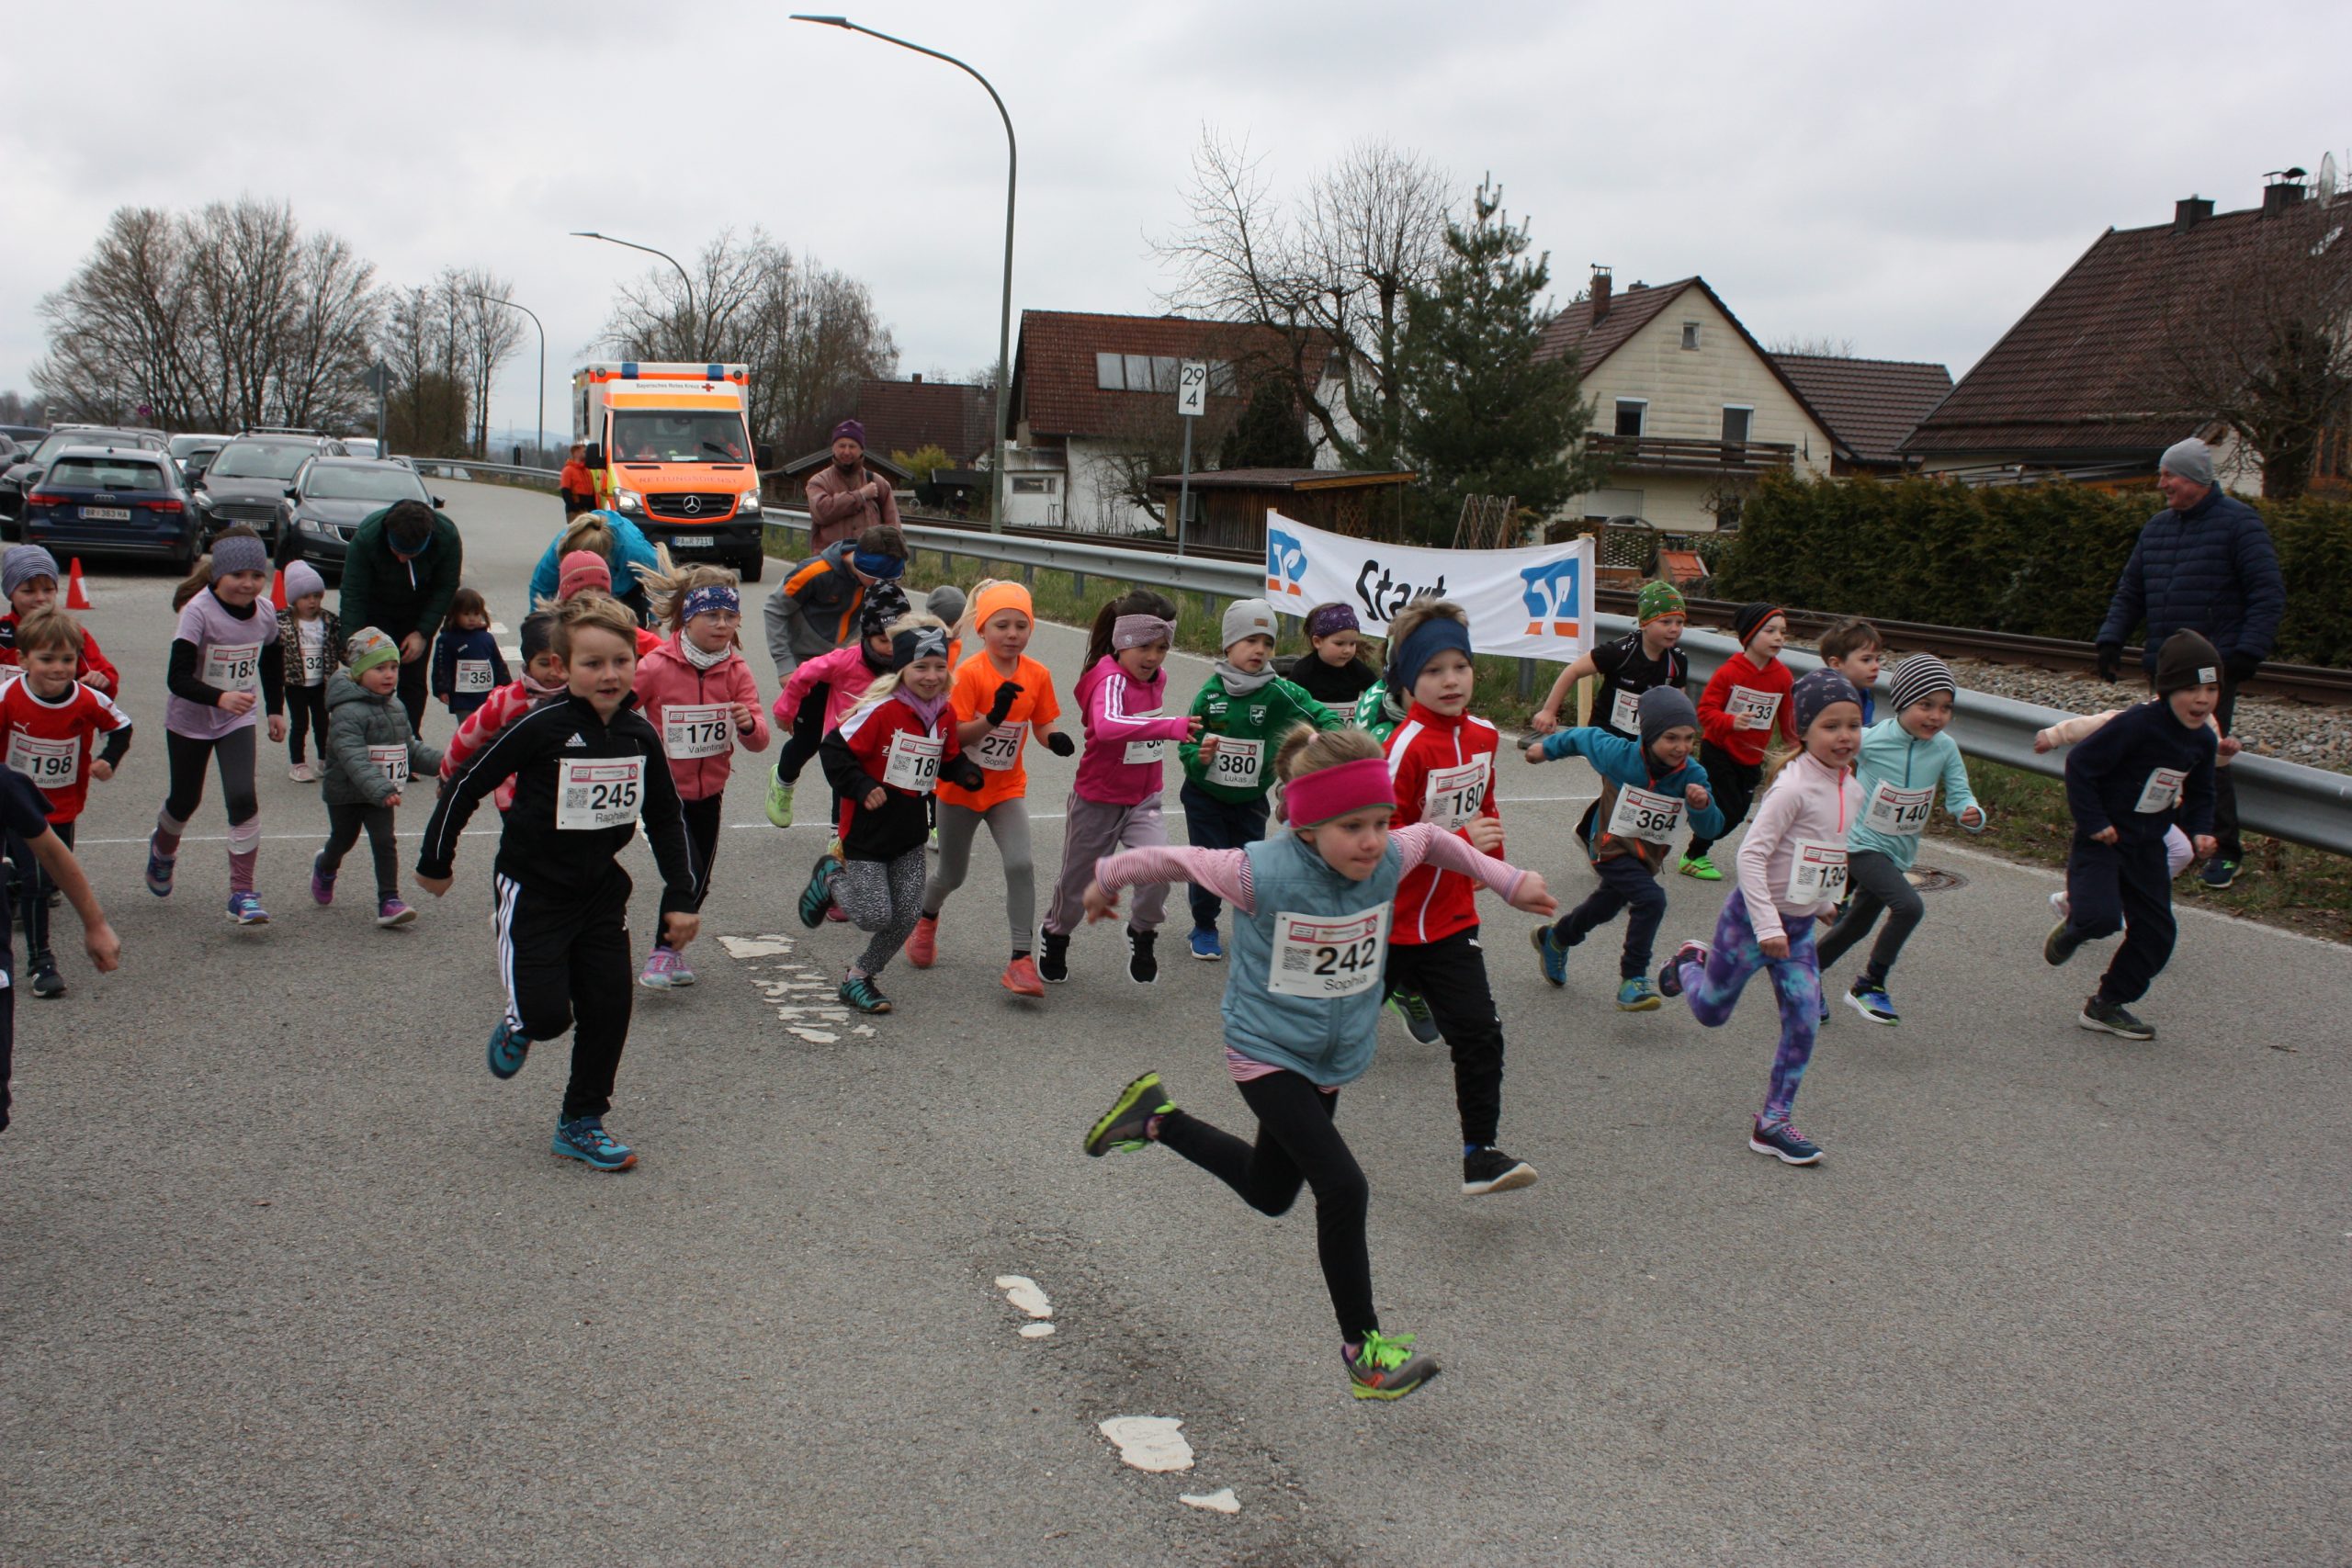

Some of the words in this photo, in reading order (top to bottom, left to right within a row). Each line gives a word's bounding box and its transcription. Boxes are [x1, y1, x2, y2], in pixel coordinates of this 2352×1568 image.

[1182, 367, 1204, 386] 29
[1185, 389, 1198, 408] 4
[228, 660, 256, 679] 183
[470, 671, 492, 683] 358
[1747, 704, 1772, 720] 133
[686, 722, 727, 744] 178
[688, 743, 725, 753] Valentina
[980, 736, 1017, 758] 276
[31, 755, 73, 776] 198
[386, 761, 407, 779] 122
[1218, 754, 1256, 775] 380
[1225, 773, 1248, 784] Lukas
[591, 782, 637, 809] 245
[1453, 782, 1484, 816] 180
[595, 809, 631, 823] Raphael
[1636, 809, 1678, 832] 364
[1894, 802, 1929, 823] 140
[1314, 937, 1376, 976] 242
